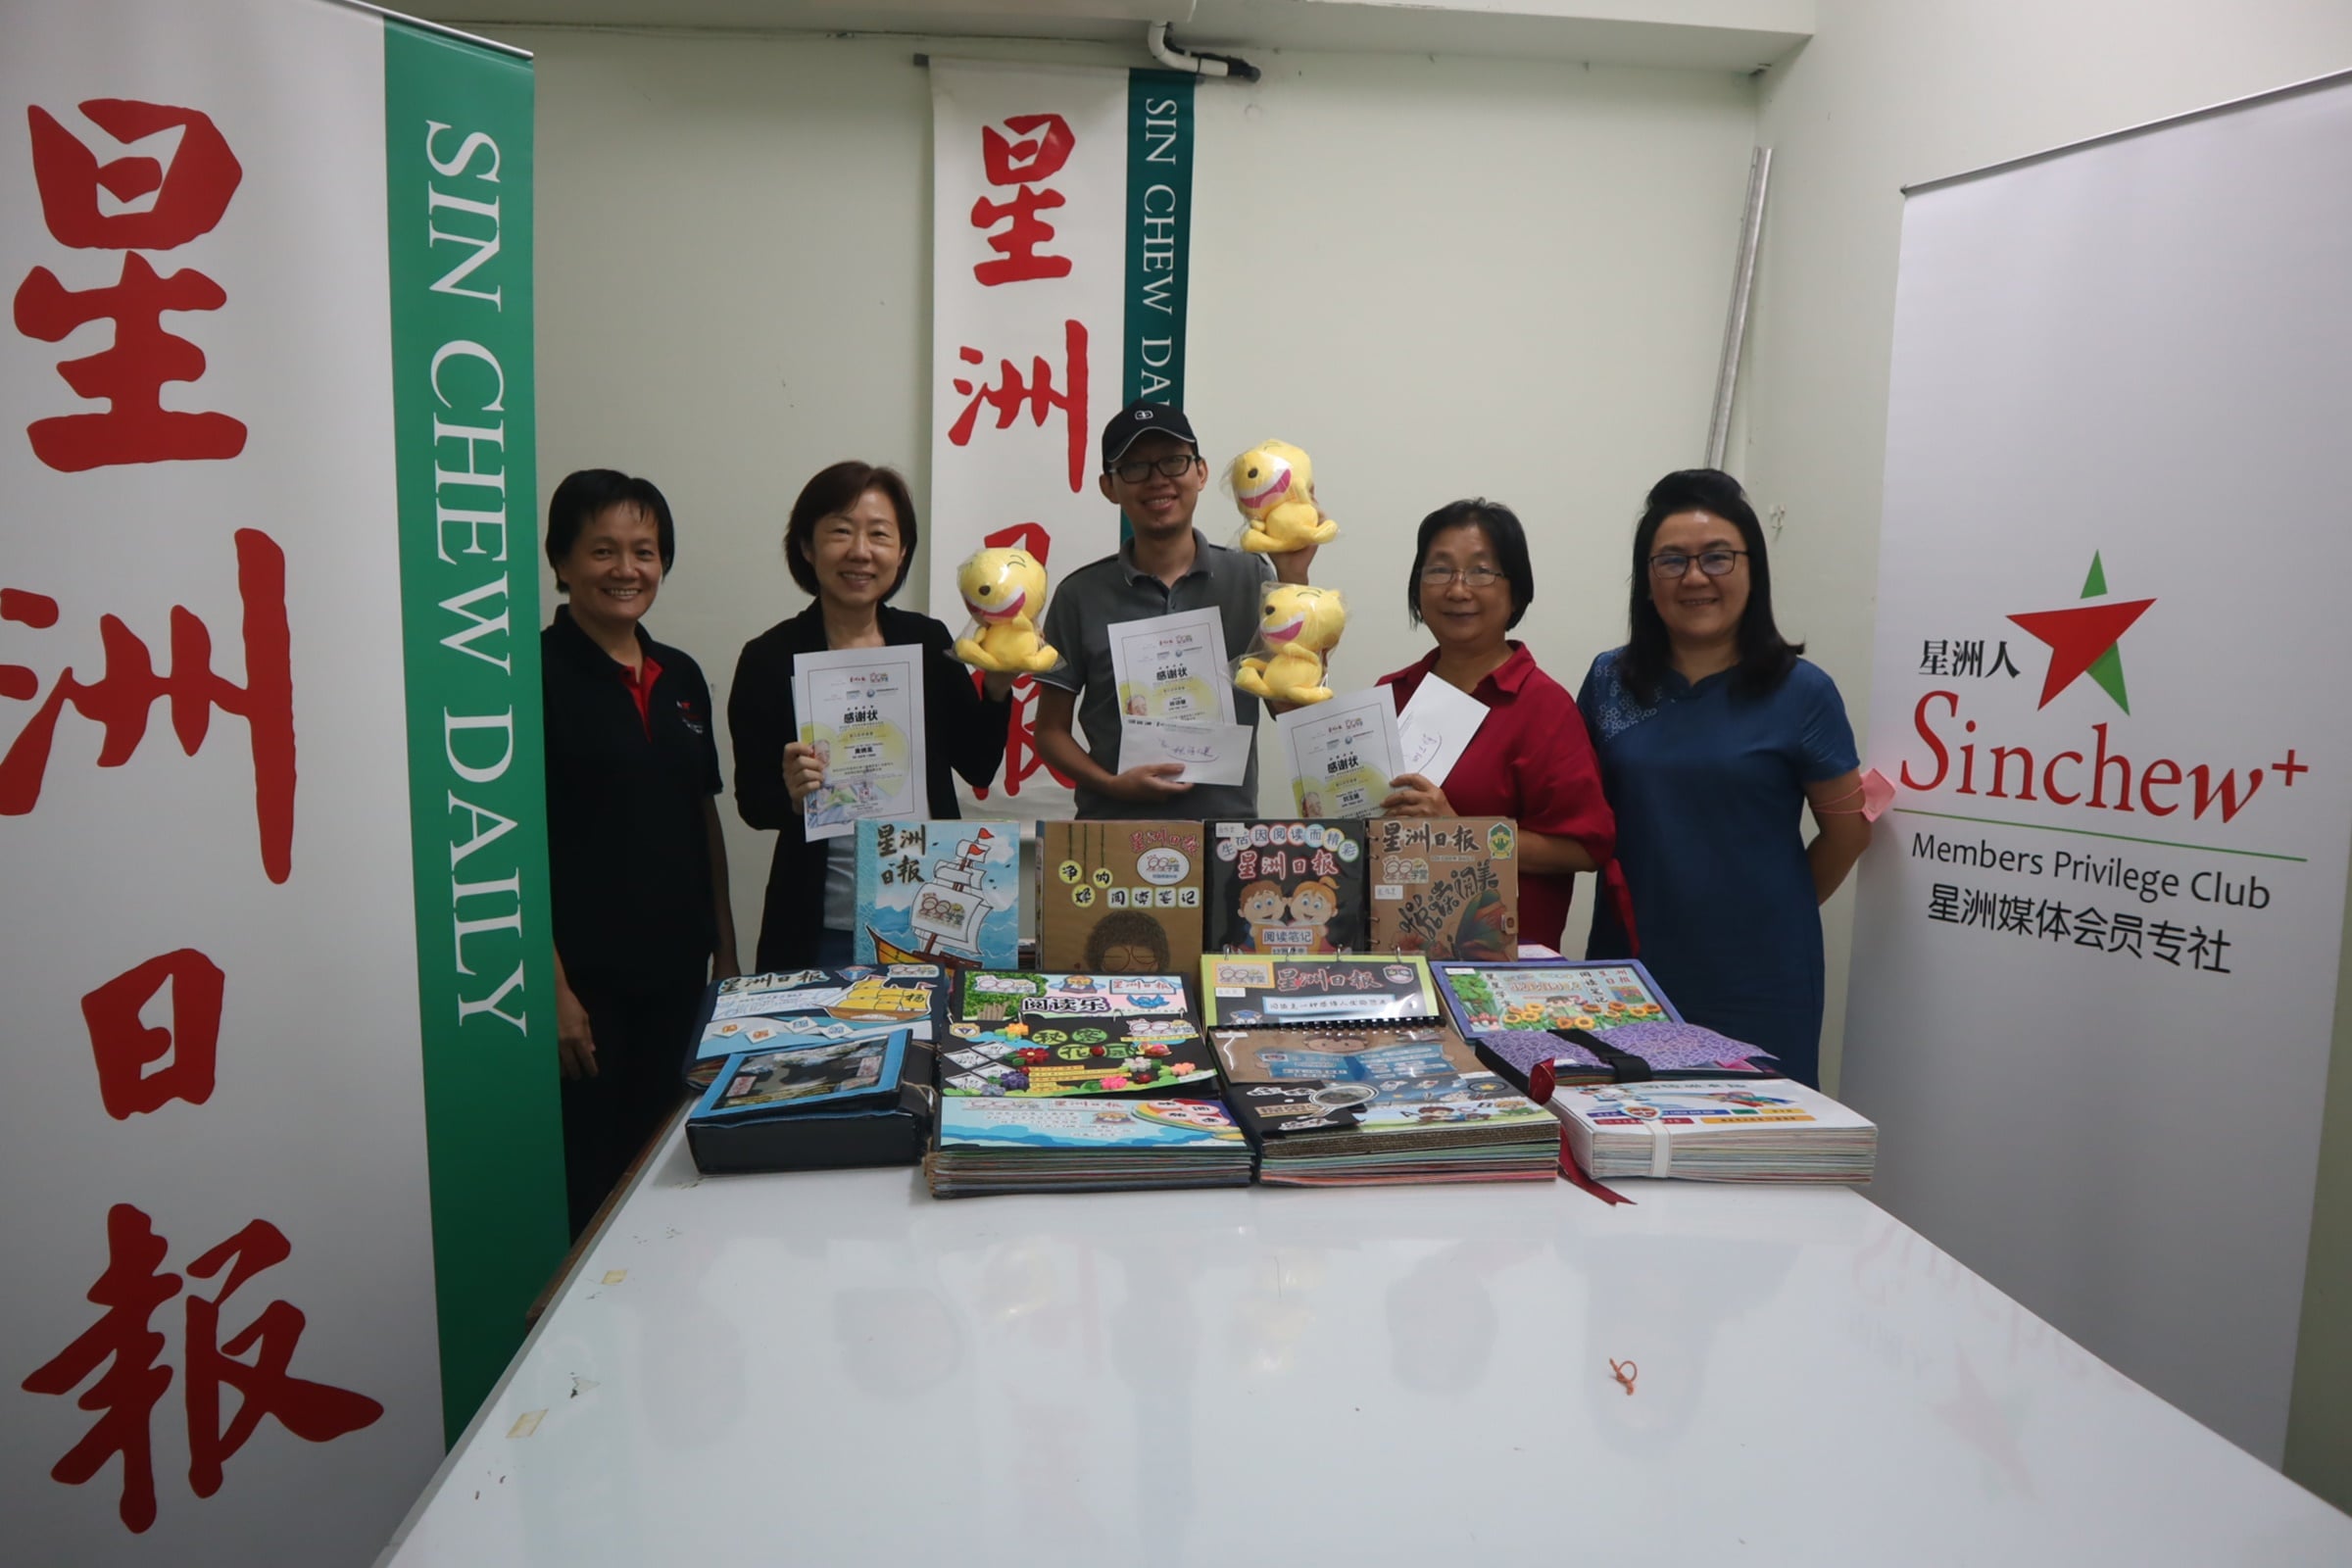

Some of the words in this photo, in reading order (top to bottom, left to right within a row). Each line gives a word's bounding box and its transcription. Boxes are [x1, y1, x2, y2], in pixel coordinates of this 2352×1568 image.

[1144, 97, 1178, 165] SIN
[424, 119, 502, 313] SIN
[1142, 184, 1177, 315] CHEW
[429, 339, 512, 676] CHEW
[1156, 666, 1188, 681] 感谢状
[1918, 639, 2021, 679] 星洲人
[844, 709, 878, 723] 感谢状
[1327, 755, 1359, 774] 感谢状
[877, 823, 926, 858] 星洲
[443, 704, 527, 1038] DAILY
[1911, 832, 2044, 875] Members
[2053, 851, 2180, 904] Privilege
[2190, 871, 2272, 909] Club
[1263, 931, 1312, 943] 阅读笔记
[1927, 882, 2231, 974] 星洲媒体会员专社
[1023, 998, 1106, 1012] 阅读乐
